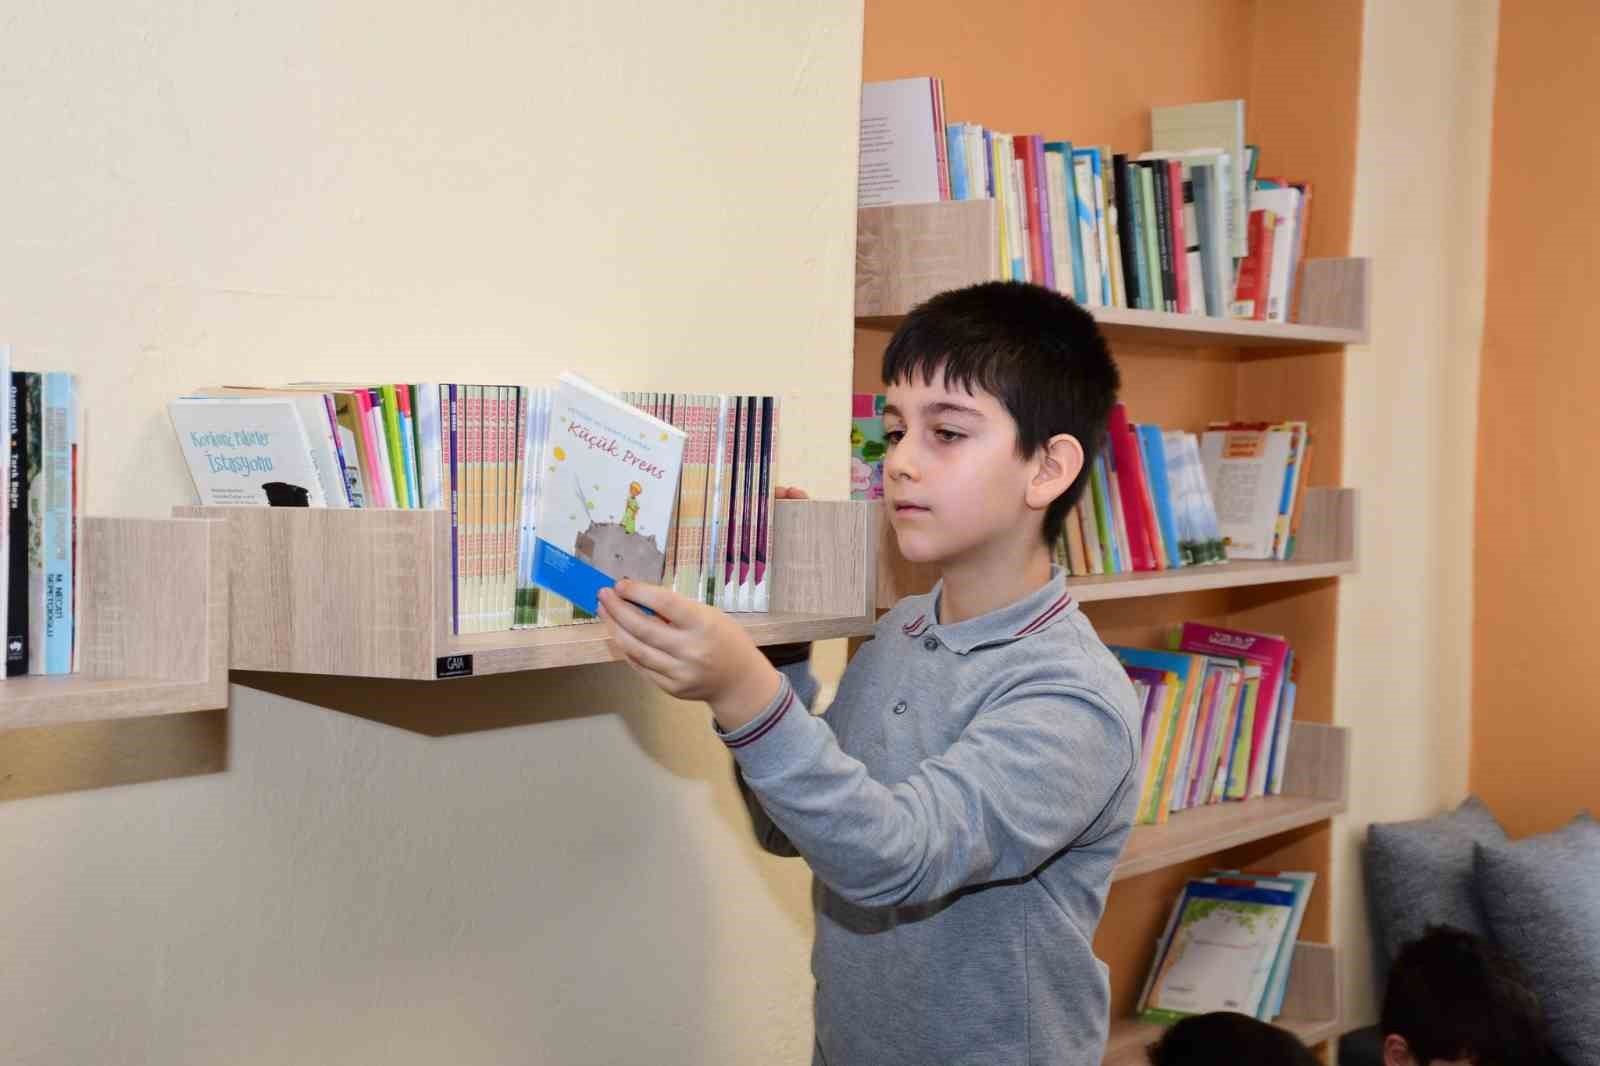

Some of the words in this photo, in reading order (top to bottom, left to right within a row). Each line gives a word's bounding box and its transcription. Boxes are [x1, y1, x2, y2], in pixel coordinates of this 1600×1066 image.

[203, 451, 274, 477] İstasyonu
[568, 421, 619, 457] Küçük
[622, 449, 666, 480] Prens
